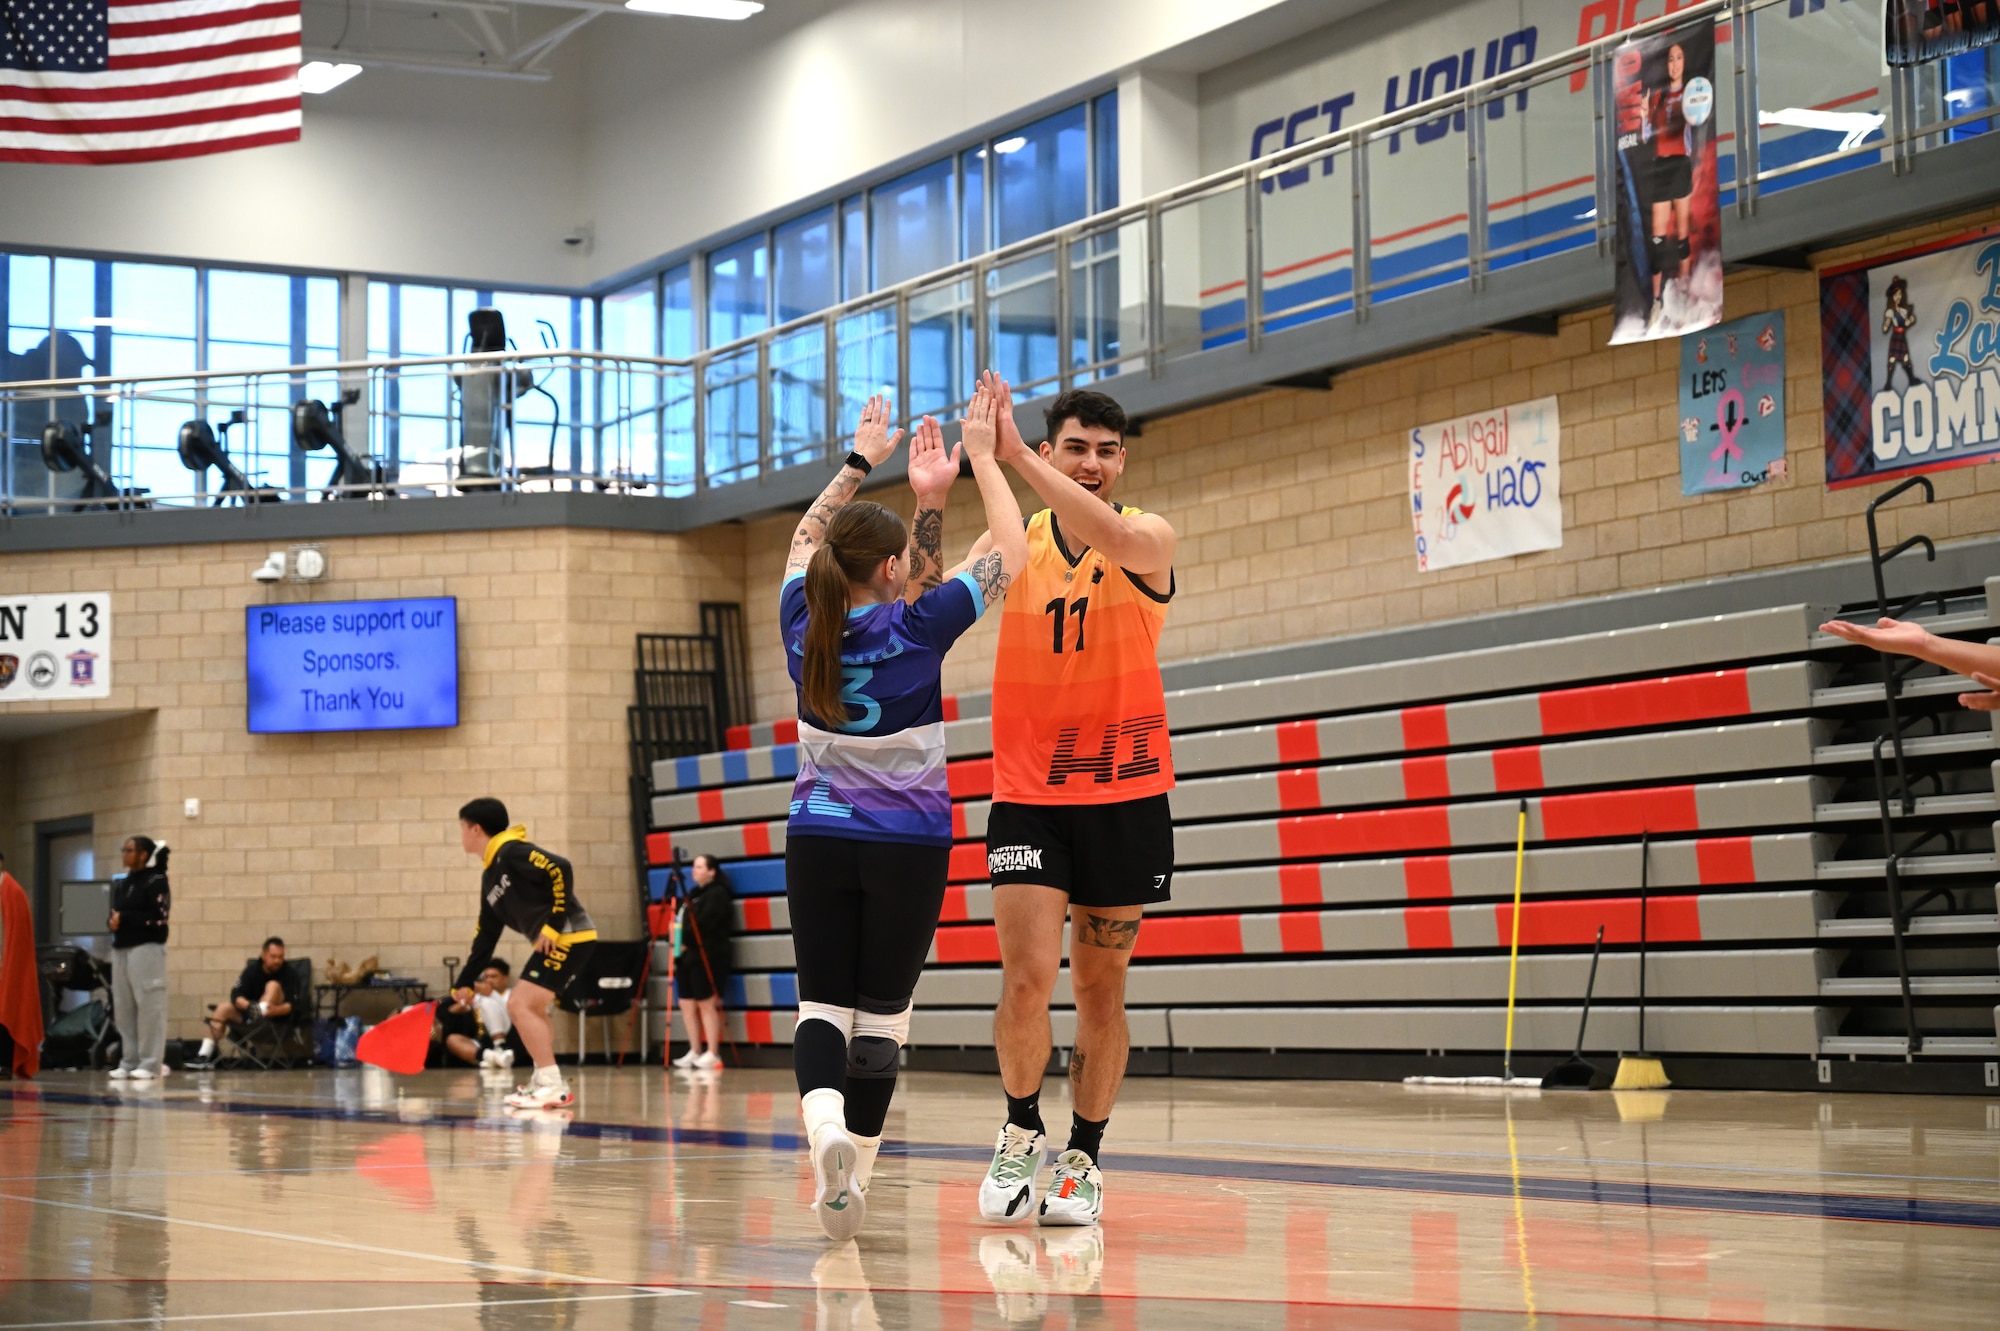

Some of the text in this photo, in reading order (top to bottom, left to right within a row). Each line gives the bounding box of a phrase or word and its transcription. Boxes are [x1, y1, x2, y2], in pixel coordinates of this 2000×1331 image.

[1251, 92, 1355, 194] GET
[1384, 26, 1538, 155] YOUR
[1692, 368, 1727, 399] LETS
[1412, 428, 1428, 571] SENIOR
[55, 602, 99, 639] 13
[260, 608, 443, 637] Please support our
[1046, 597, 1088, 654] 11
[303, 648, 400, 678] Sponsors.
[301, 686, 404, 712] Thank You
[837, 664, 882, 733] 3
[1047, 713, 1165, 786] HI
[528, 849, 566, 914] VOLLEYBALL
[993, 864, 1027, 874] CLUB
